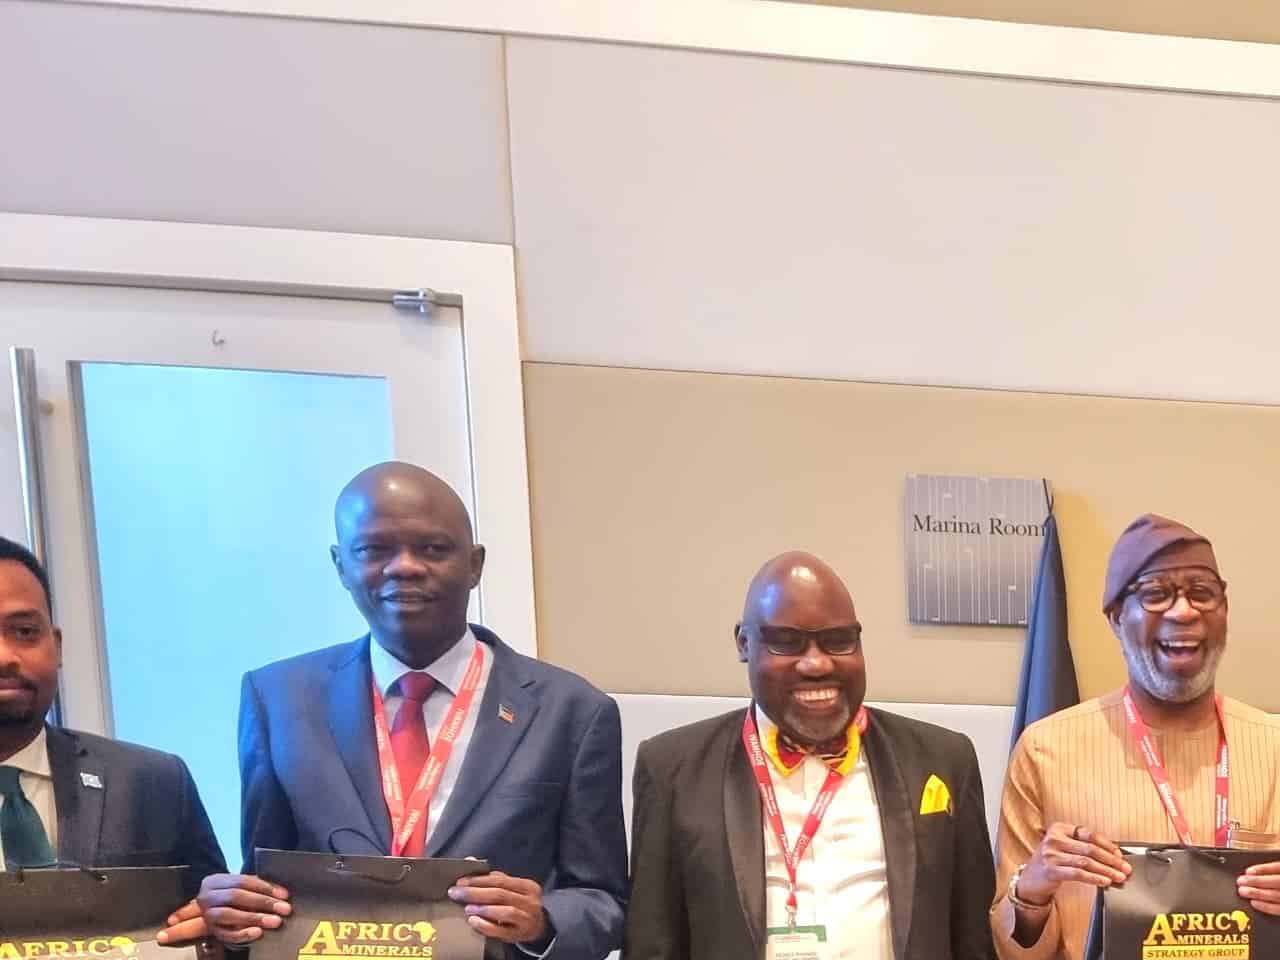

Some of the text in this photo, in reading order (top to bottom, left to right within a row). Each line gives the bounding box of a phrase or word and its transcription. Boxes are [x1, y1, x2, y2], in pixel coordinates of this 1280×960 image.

[912, 514, 982, 535] Marina
[1176, 934, 1250, 945] MINERALS
[342, 945, 433, 957] MINERALS
[1147, 948, 1245, 958] STRATEGY GROUP
